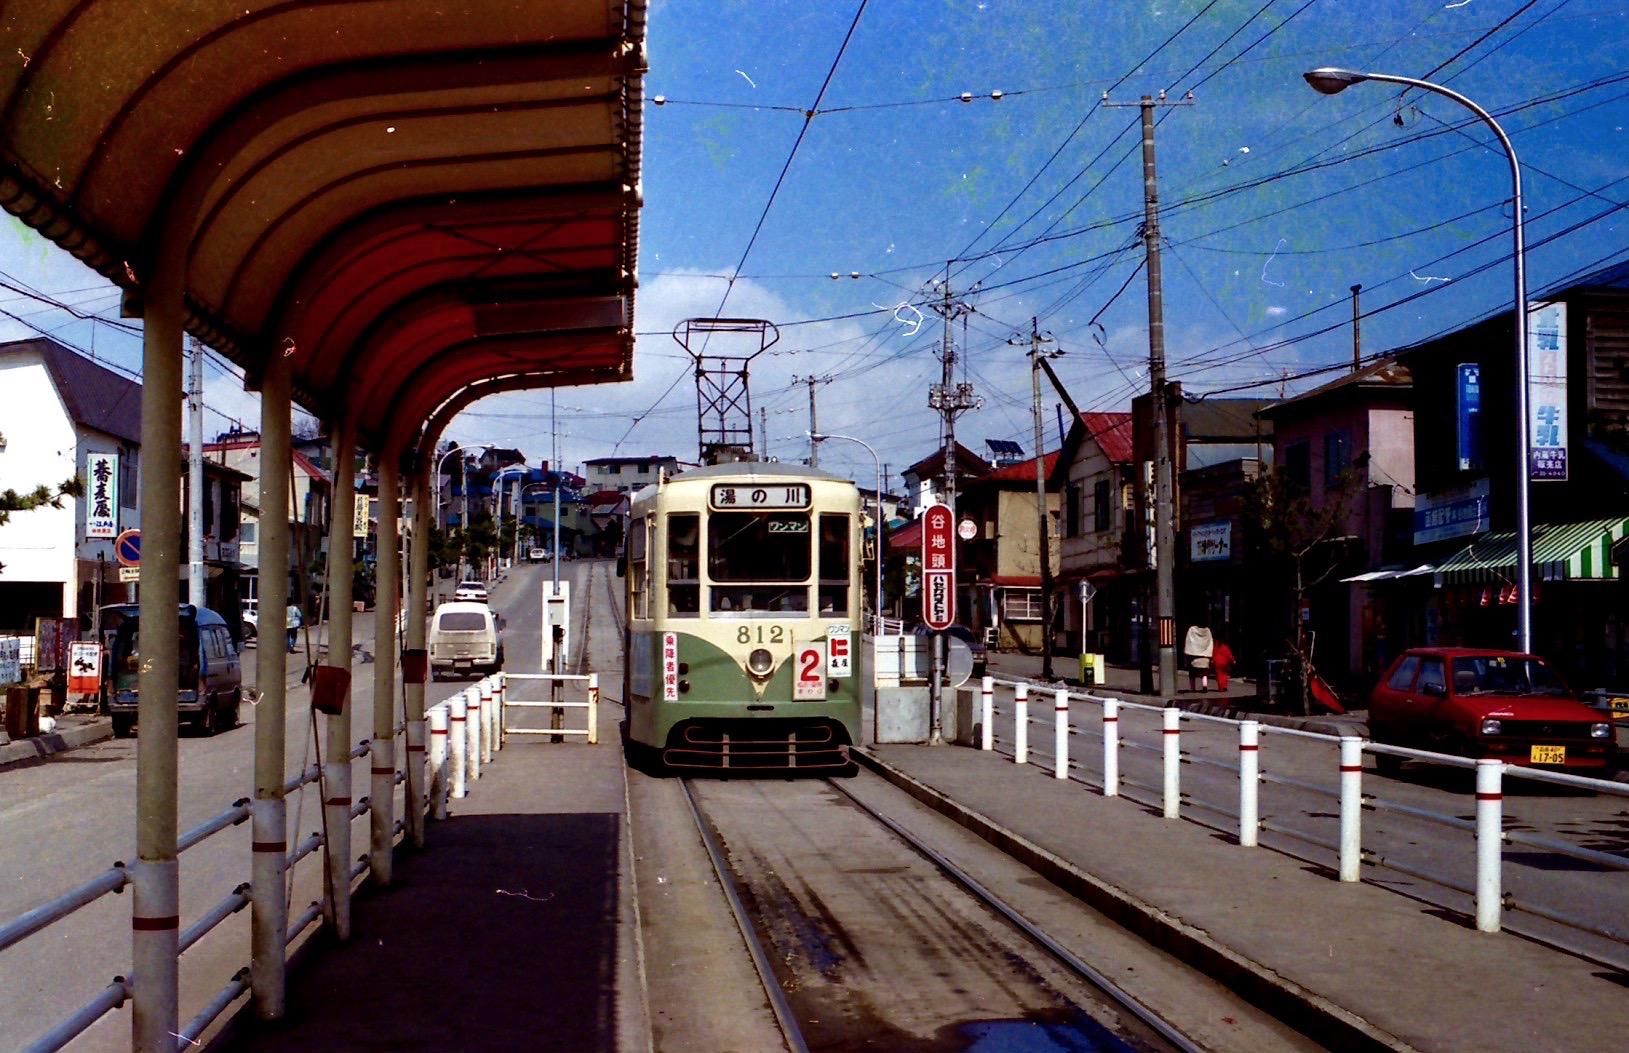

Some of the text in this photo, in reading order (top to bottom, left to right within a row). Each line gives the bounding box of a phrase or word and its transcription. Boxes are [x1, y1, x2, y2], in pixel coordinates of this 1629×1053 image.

[720, 488, 800, 504] 湯の川
[770, 521, 808, 532] ワンマン
[930, 514, 946, 568] 谷地頭
[737, 625, 784, 644] 812
[828, 625, 850, 634] ワンマン
[665, 635, 676, 697] 乗降者優先
[800, 649, 820, 681] 2
[1539, 753, 1564, 763] 17-05
